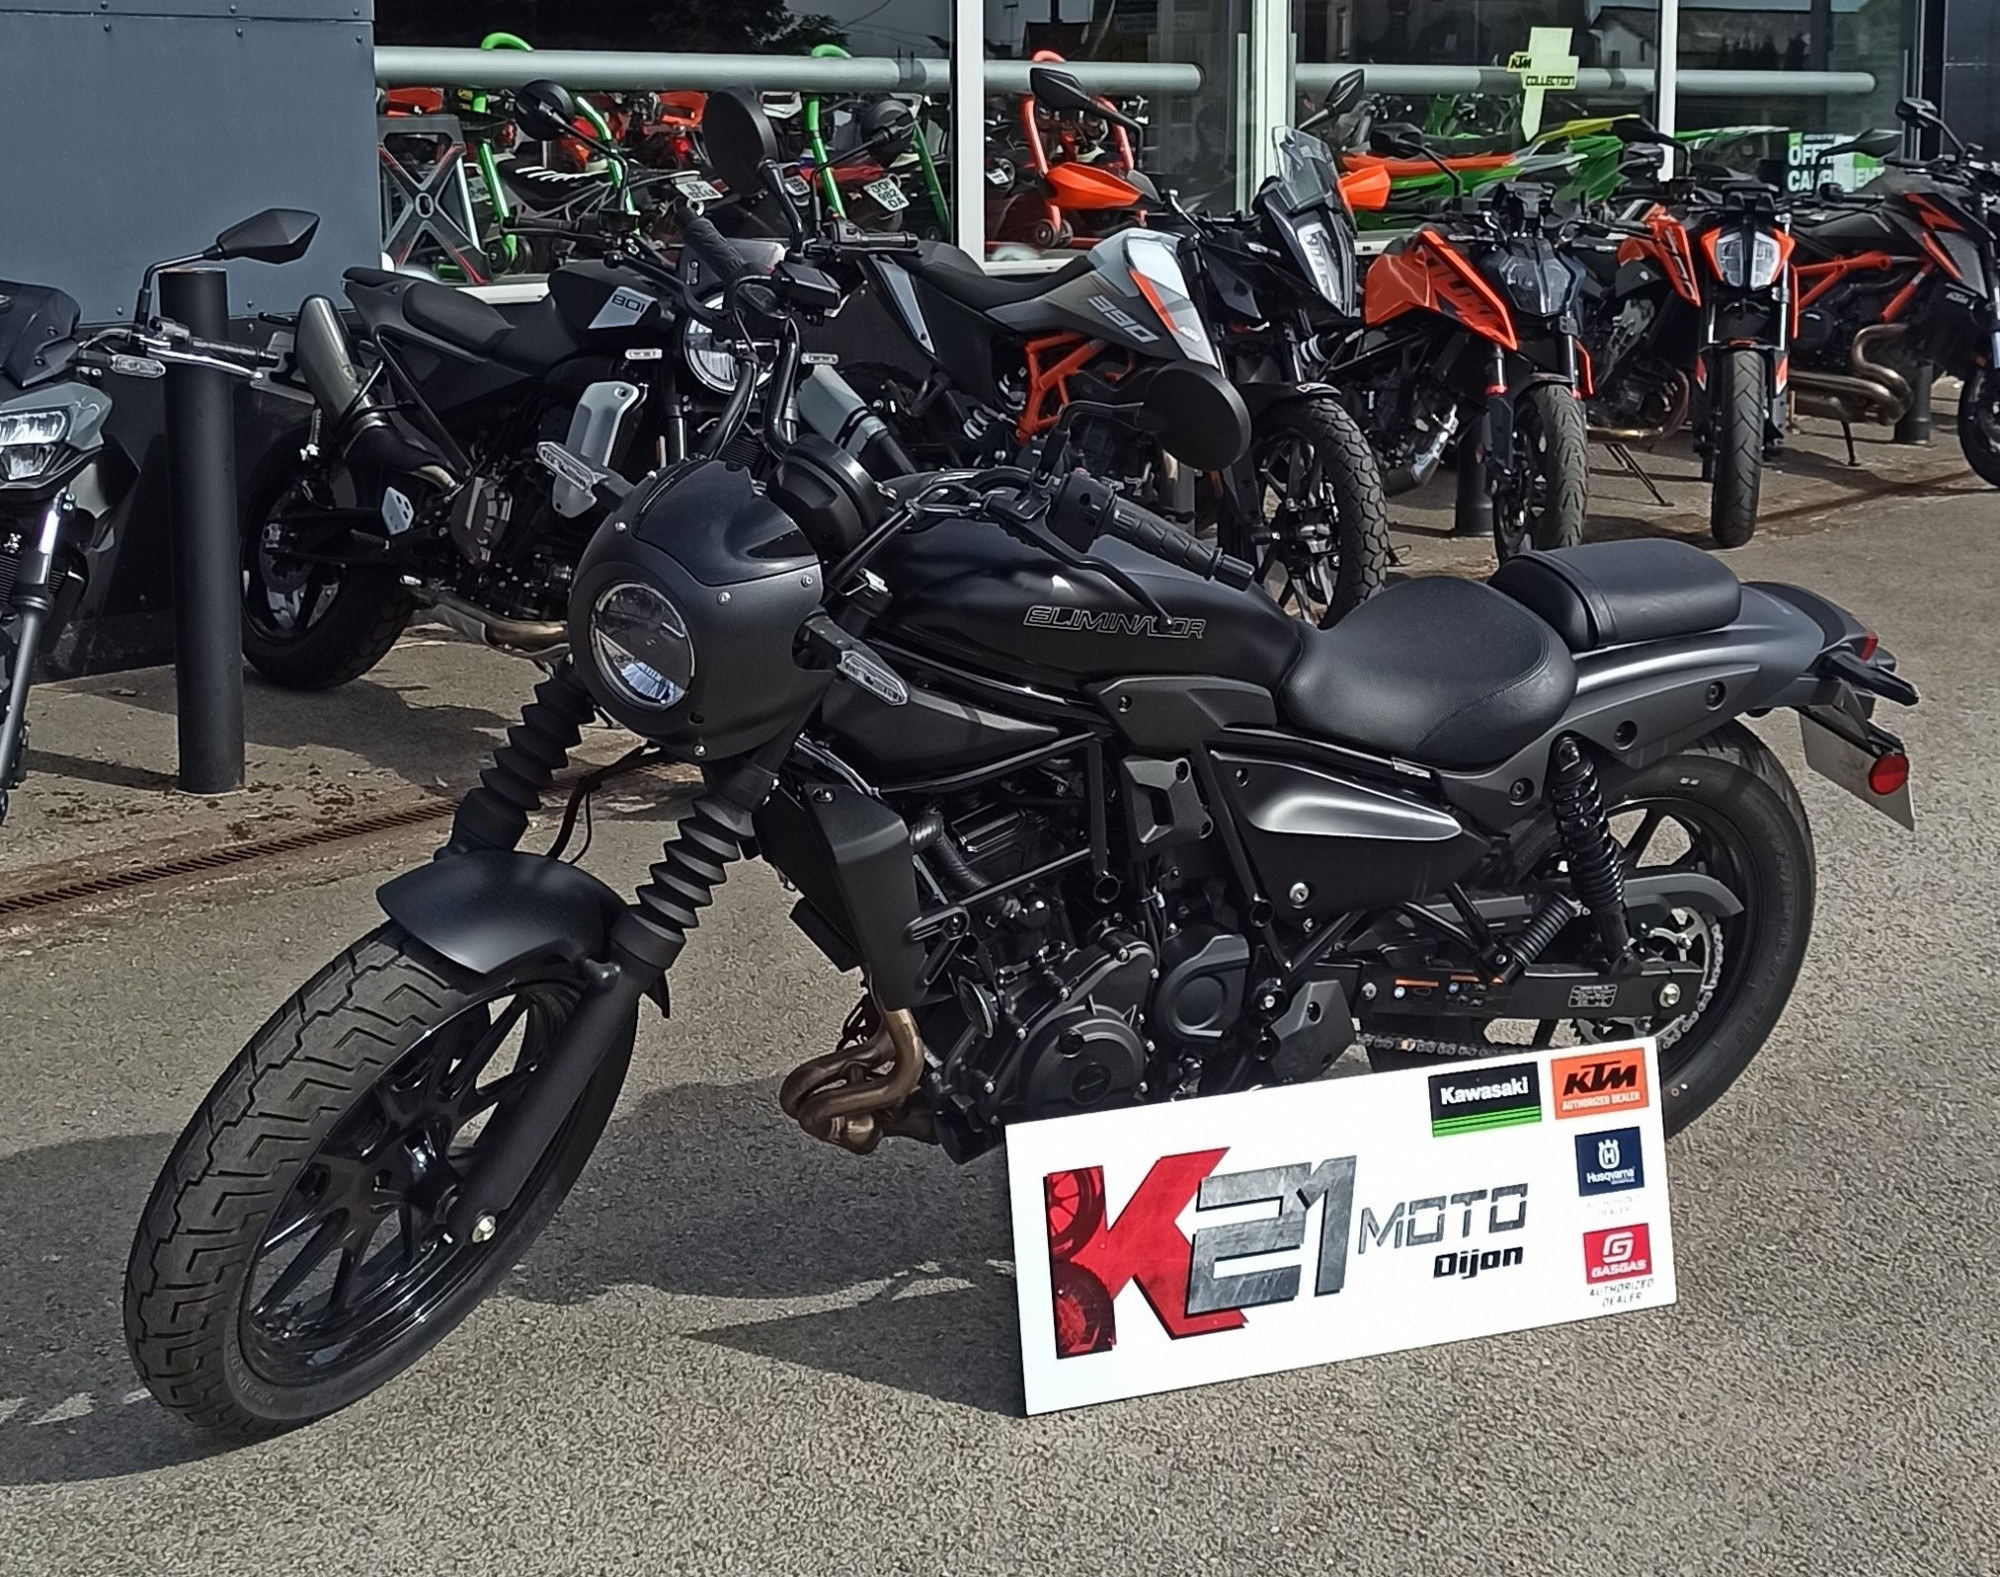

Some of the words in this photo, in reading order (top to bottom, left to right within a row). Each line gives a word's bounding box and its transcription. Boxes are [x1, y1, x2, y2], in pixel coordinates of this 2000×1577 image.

[1511, 55, 1531, 69] KTM
[1525, 76, 1575, 86] COLLECTION
[612, 294, 645, 313] 801
[1088, 295, 1159, 343] 390
[1563, 1061, 1637, 1096] KTM
[1441, 1076, 1528, 1105] Kawasaki
[1587, 1167, 1635, 1184] Husqvarna
[1358, 1183, 1528, 1254] MOTO
[1433, 1247, 1523, 1279] Dijon
[1591, 1260, 1647, 1278] GASGAS
[1590, 1278, 1654, 1296] AUTHORIZED
[1602, 1292, 1642, 1307] DEALER
